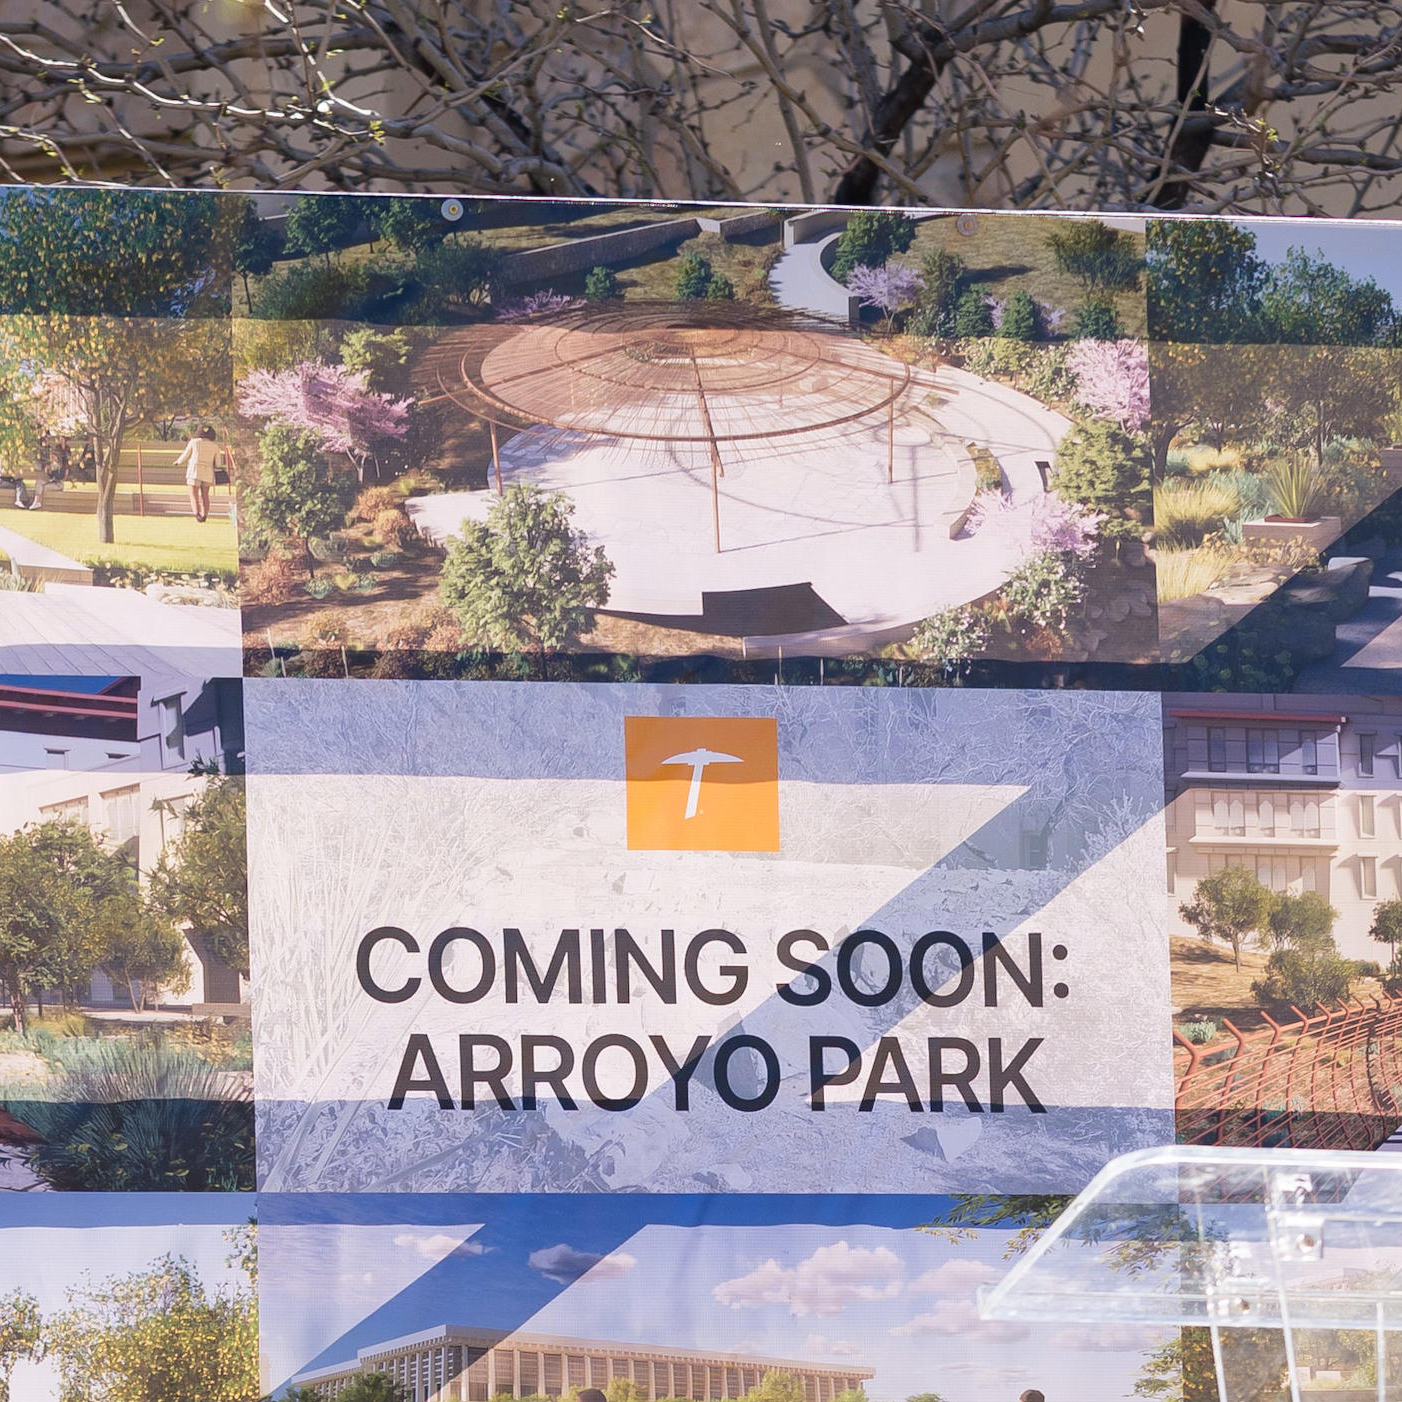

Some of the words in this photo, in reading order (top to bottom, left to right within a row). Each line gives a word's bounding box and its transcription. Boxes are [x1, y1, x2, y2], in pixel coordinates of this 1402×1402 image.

[357, 927, 748, 1006] COMING
[776, 930, 1069, 1008] SOON:
[388, 1034, 781, 1112] ARROYO
[809, 1036, 1048, 1114] PARK
